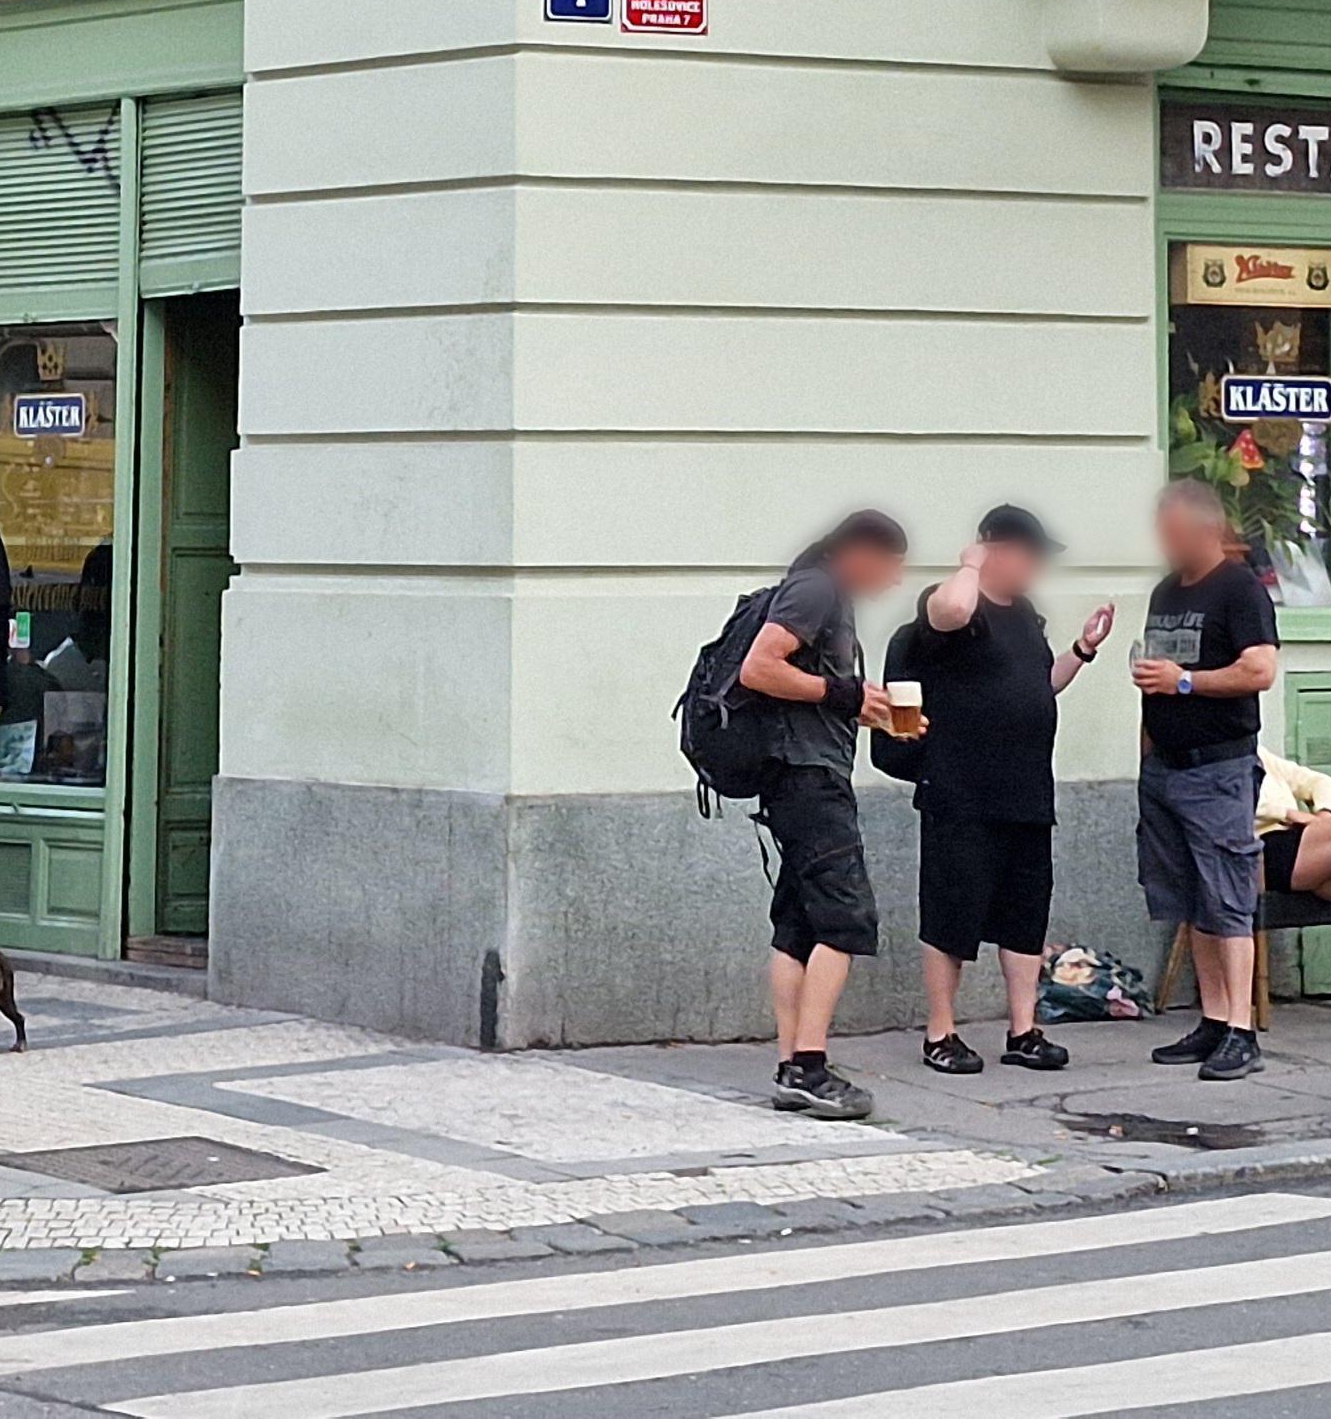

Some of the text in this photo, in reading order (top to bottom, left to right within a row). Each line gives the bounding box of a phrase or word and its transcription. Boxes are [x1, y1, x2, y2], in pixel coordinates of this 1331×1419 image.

[630, 0, 701, 13] HOLEŠOVICE
[641, 13, 691, 26] PRAHA 7
[1228, 382, 1330, 413] KLÁŠTER
